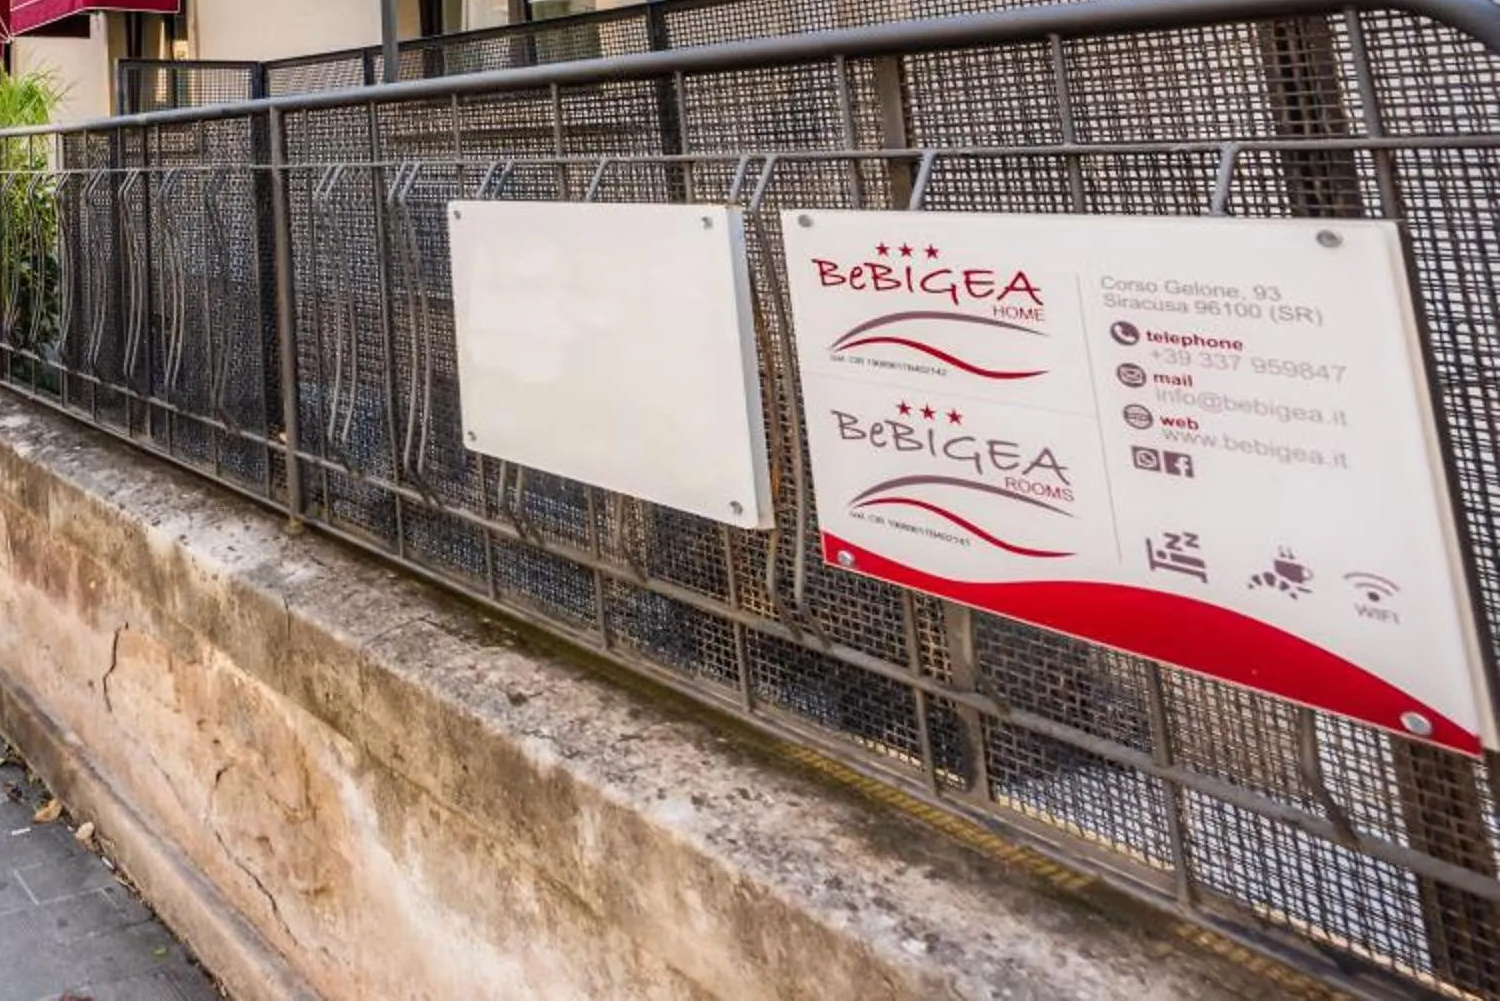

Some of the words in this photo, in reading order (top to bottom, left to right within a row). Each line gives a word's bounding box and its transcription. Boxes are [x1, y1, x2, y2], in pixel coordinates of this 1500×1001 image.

[1100, 275, 1158, 294] Corso
[1165, 280, 1247, 301] Gelone,
[1253, 284, 1282, 302] 93
[993, 306, 1045, 321] HOME
[1103, 293, 1189, 314] Siracusa
[1194, 299, 1262, 319] 96100
[1269, 304, 1324, 327] (SR)
[1146, 330, 1243, 351] telephone
[1150, 347, 1191, 367] +39
[1200, 352, 1241, 372] 337
[1251, 356, 1347, 383] 959847
[1153, 372, 1194, 388] mail
[1156, 388, 1349, 428] info@bebigea.it
[1160, 414, 1200, 431] web
[1162, 428, 1349, 470] www.bebigea.it
[1004, 476, 1075, 502] ROOMS
